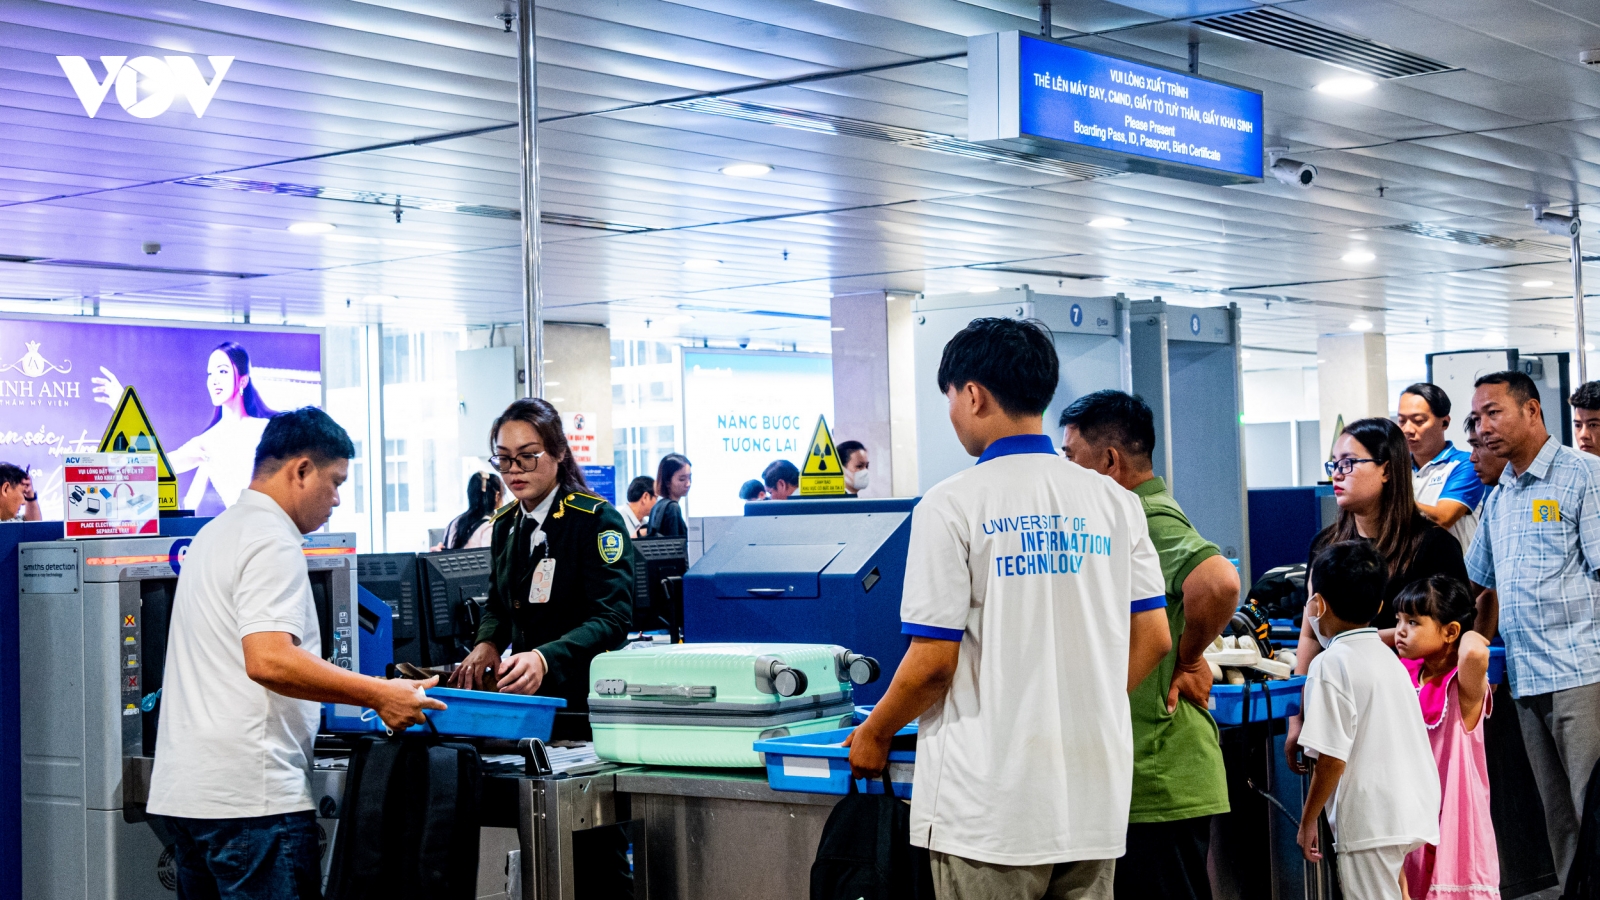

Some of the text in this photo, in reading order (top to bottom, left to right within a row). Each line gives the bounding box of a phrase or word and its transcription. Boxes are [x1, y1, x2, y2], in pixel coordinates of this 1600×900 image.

[1110, 69, 1188, 99] VUI LÒNG XUẤT TRÌNH
[1033, 72, 1051, 88] THẺ
[1052, 76, 1068, 92] LÊN
[1070, 80, 1088, 96] MÁY
[1089, 86, 1107, 103] BAY,
[1108, 90, 1133, 108] CMND,
[1134, 94, 1152, 111] GIẤY
[1153, 99, 1164, 113] TỜ
[1180, 106, 1202, 123] THÂN,
[1203, 109, 1219, 126] GIẤY
[1220, 115, 1236, 130] KHAI
[1237, 119, 1253, 133] SINH
[1124, 115, 1175, 137] Please Present
[1074, 120, 1221, 161] Boarding Pass, ID, Passport, Birth Certificate
[1073, 308, 1079, 322] 7
[1192, 317, 1199, 331] 8
[39, 381, 80, 398] ANH
[776, 438, 797, 452] LAI
[1073, 517, 1086, 531] OF
[1021, 531, 1111, 556] INFRMATION
[24, 563, 44, 571] smiths
[996, 553, 1083, 577] TECHNLOGY
